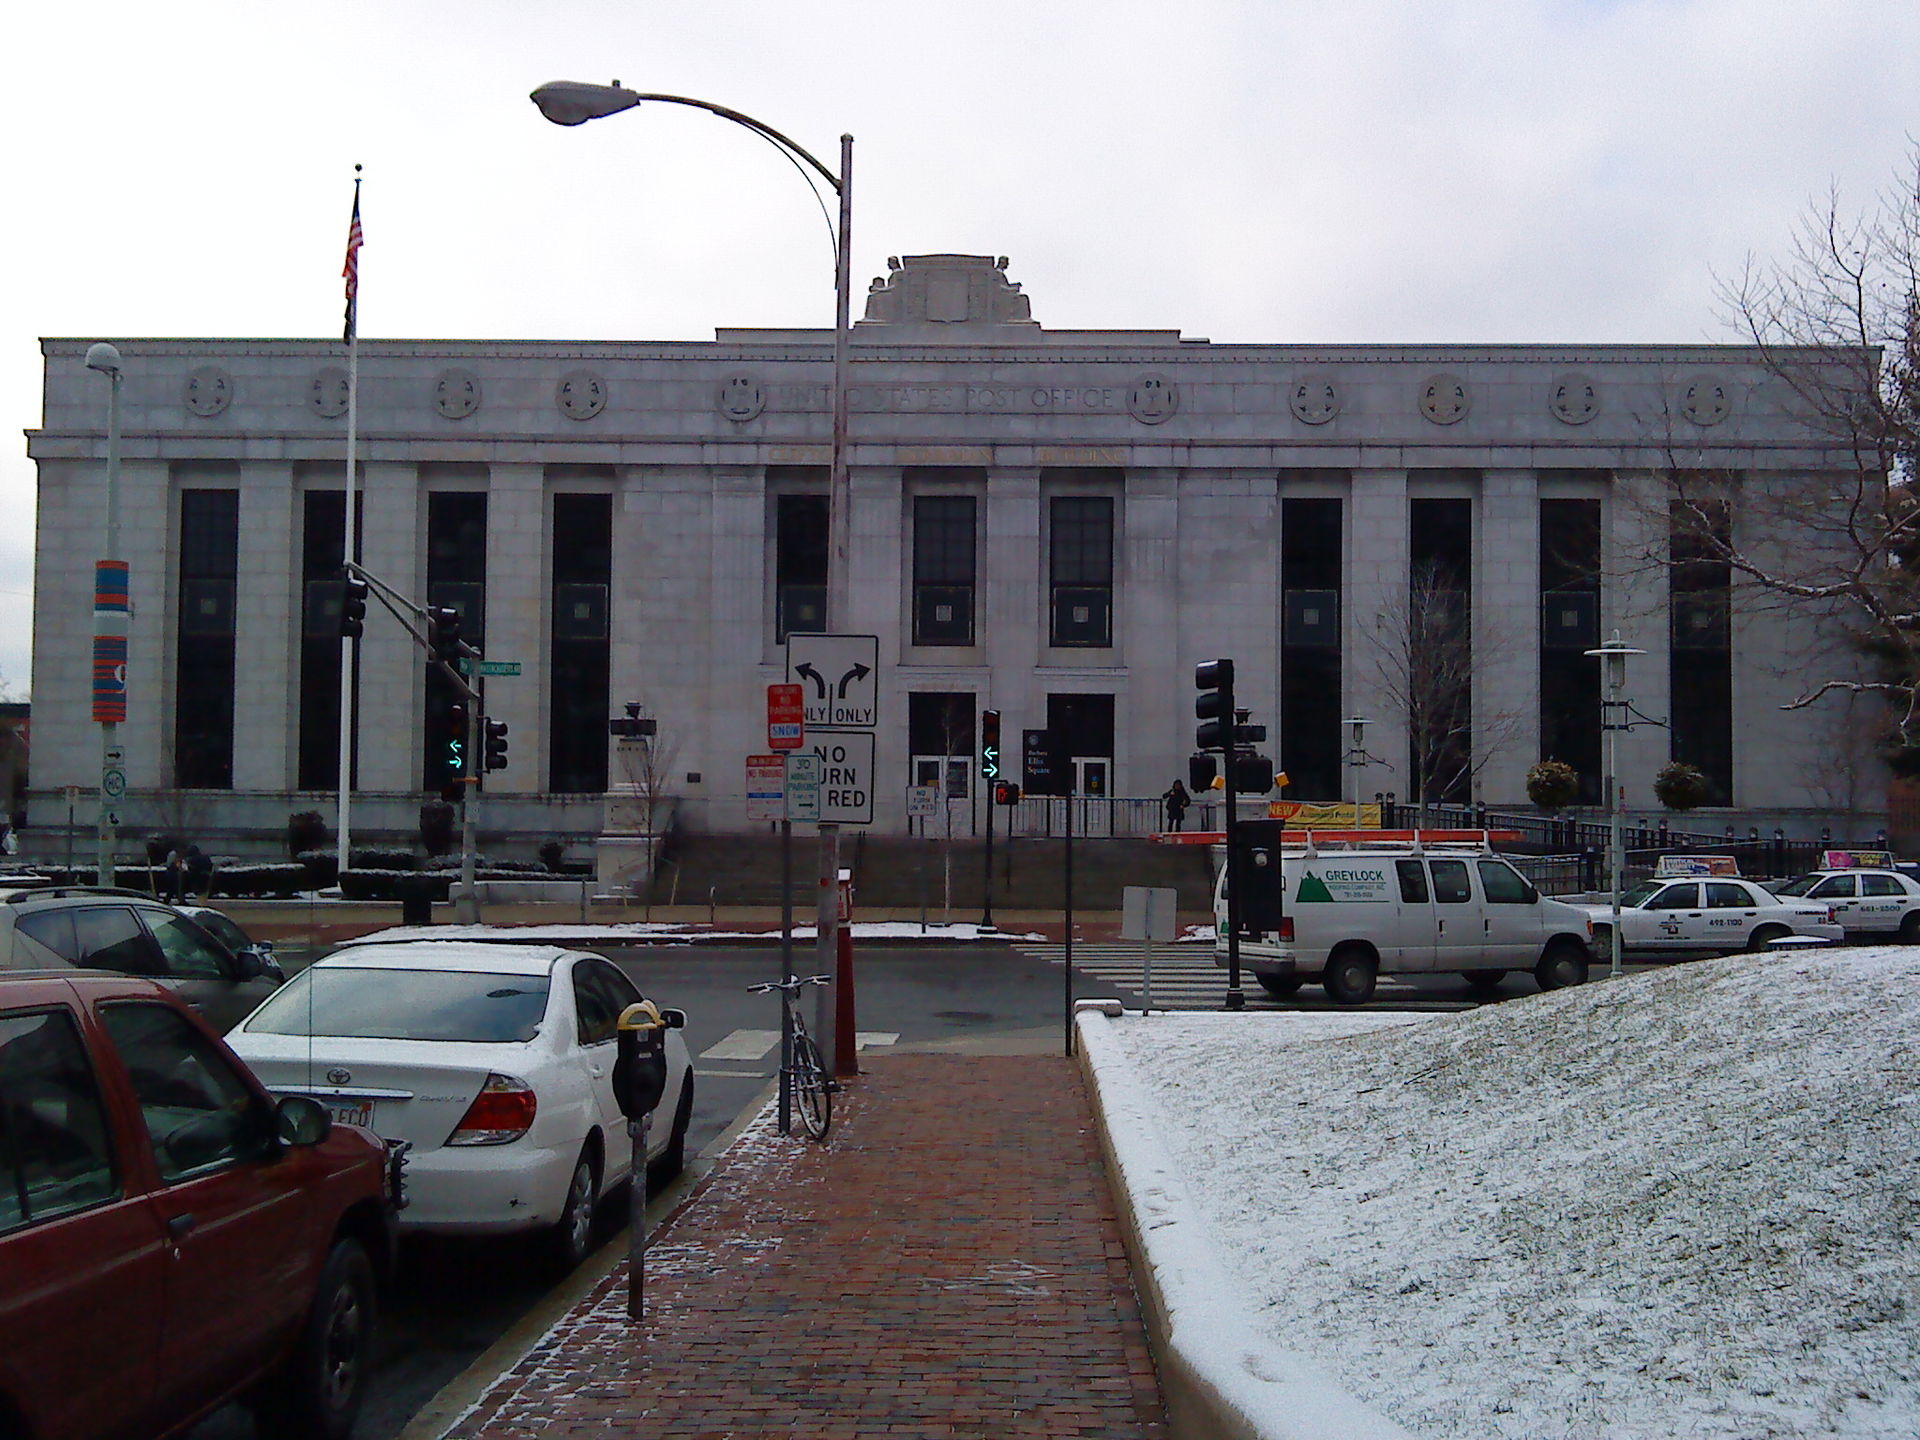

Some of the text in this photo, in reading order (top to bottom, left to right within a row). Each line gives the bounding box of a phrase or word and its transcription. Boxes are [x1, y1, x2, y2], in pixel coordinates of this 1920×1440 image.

[874, 387, 953, 407] STATES
[966, 388, 1021, 407] POST
[1032, 388, 1113, 407] OFFICE
[835, 708, 871, 722] ONLY
[772, 726, 799, 736] SNOW
[814, 745, 846, 763] NO
[796, 759, 811, 769] 30
[828, 790, 865, 807] RED
[1325, 870, 1384, 881] GREYLOCK
